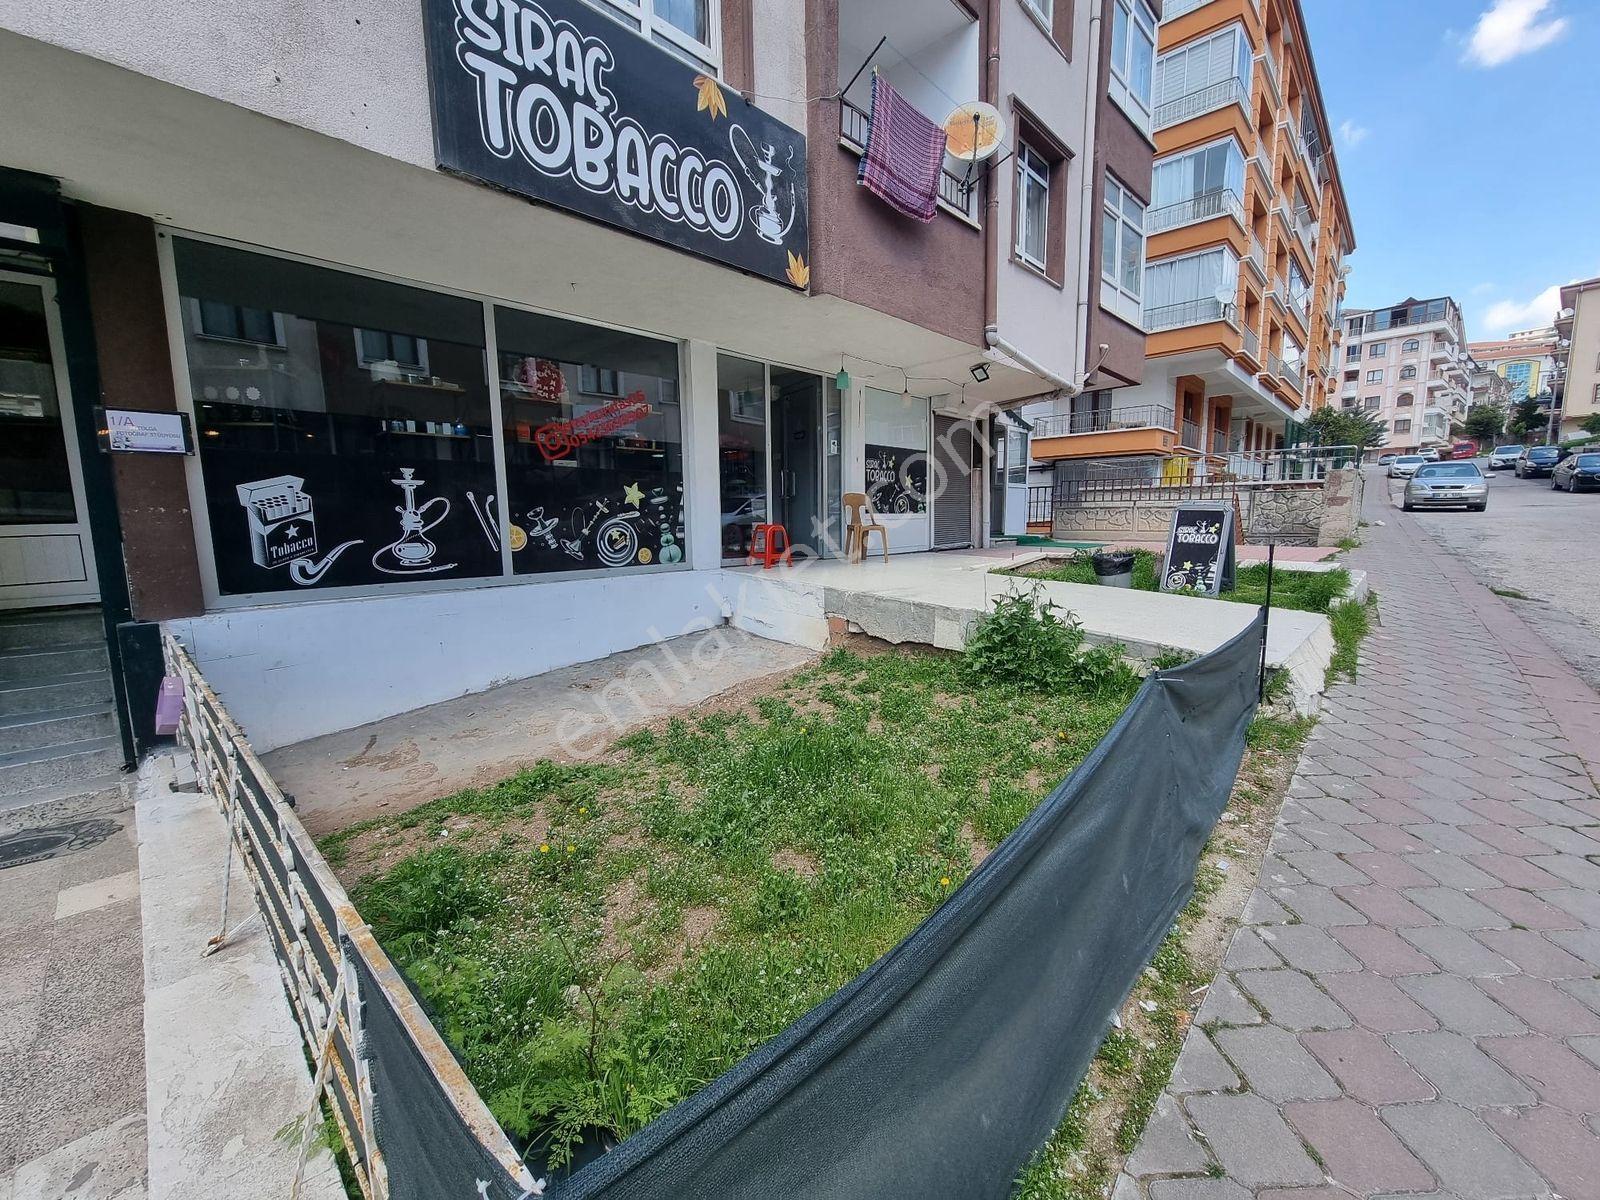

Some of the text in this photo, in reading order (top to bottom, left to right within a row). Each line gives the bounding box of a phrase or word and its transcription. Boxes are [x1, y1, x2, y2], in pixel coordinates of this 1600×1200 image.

[461, 0, 611, 112] SIRAÇ
[464, 51, 740, 236] TOBACCO
[110, 416, 134, 426] 1/A
[865, 469, 895, 482] TOBACCO
[1178, 534, 1218, 544] TOBACCO
[270, 537, 314, 559] Tobacco
